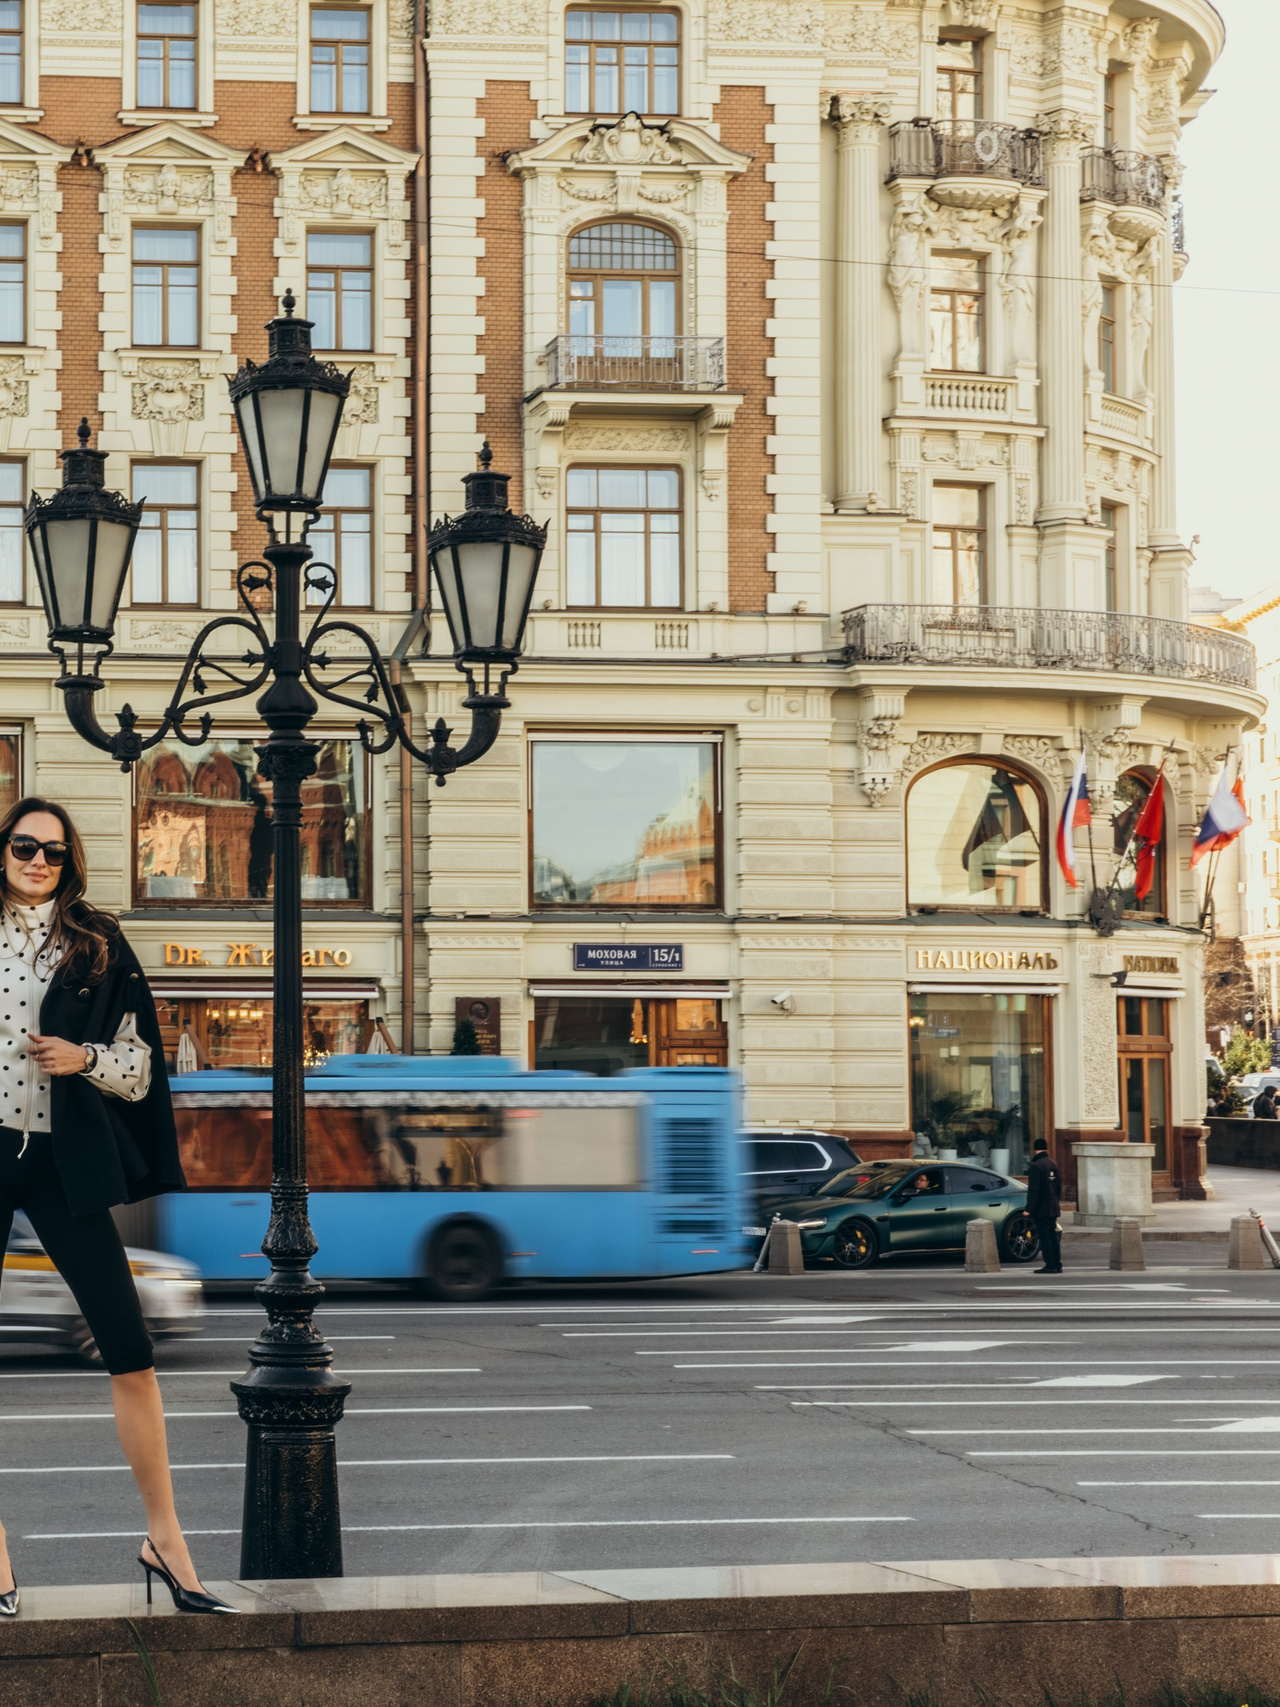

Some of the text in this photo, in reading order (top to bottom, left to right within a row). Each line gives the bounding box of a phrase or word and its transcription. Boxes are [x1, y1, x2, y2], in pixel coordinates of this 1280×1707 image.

[226, 943, 353, 967] Жиаго
[587, 949, 637, 959] МОХОВАЯ
[652, 948, 680, 963] 15/1
[916, 949, 1059, 972] НАЦИОНАЛЬ
